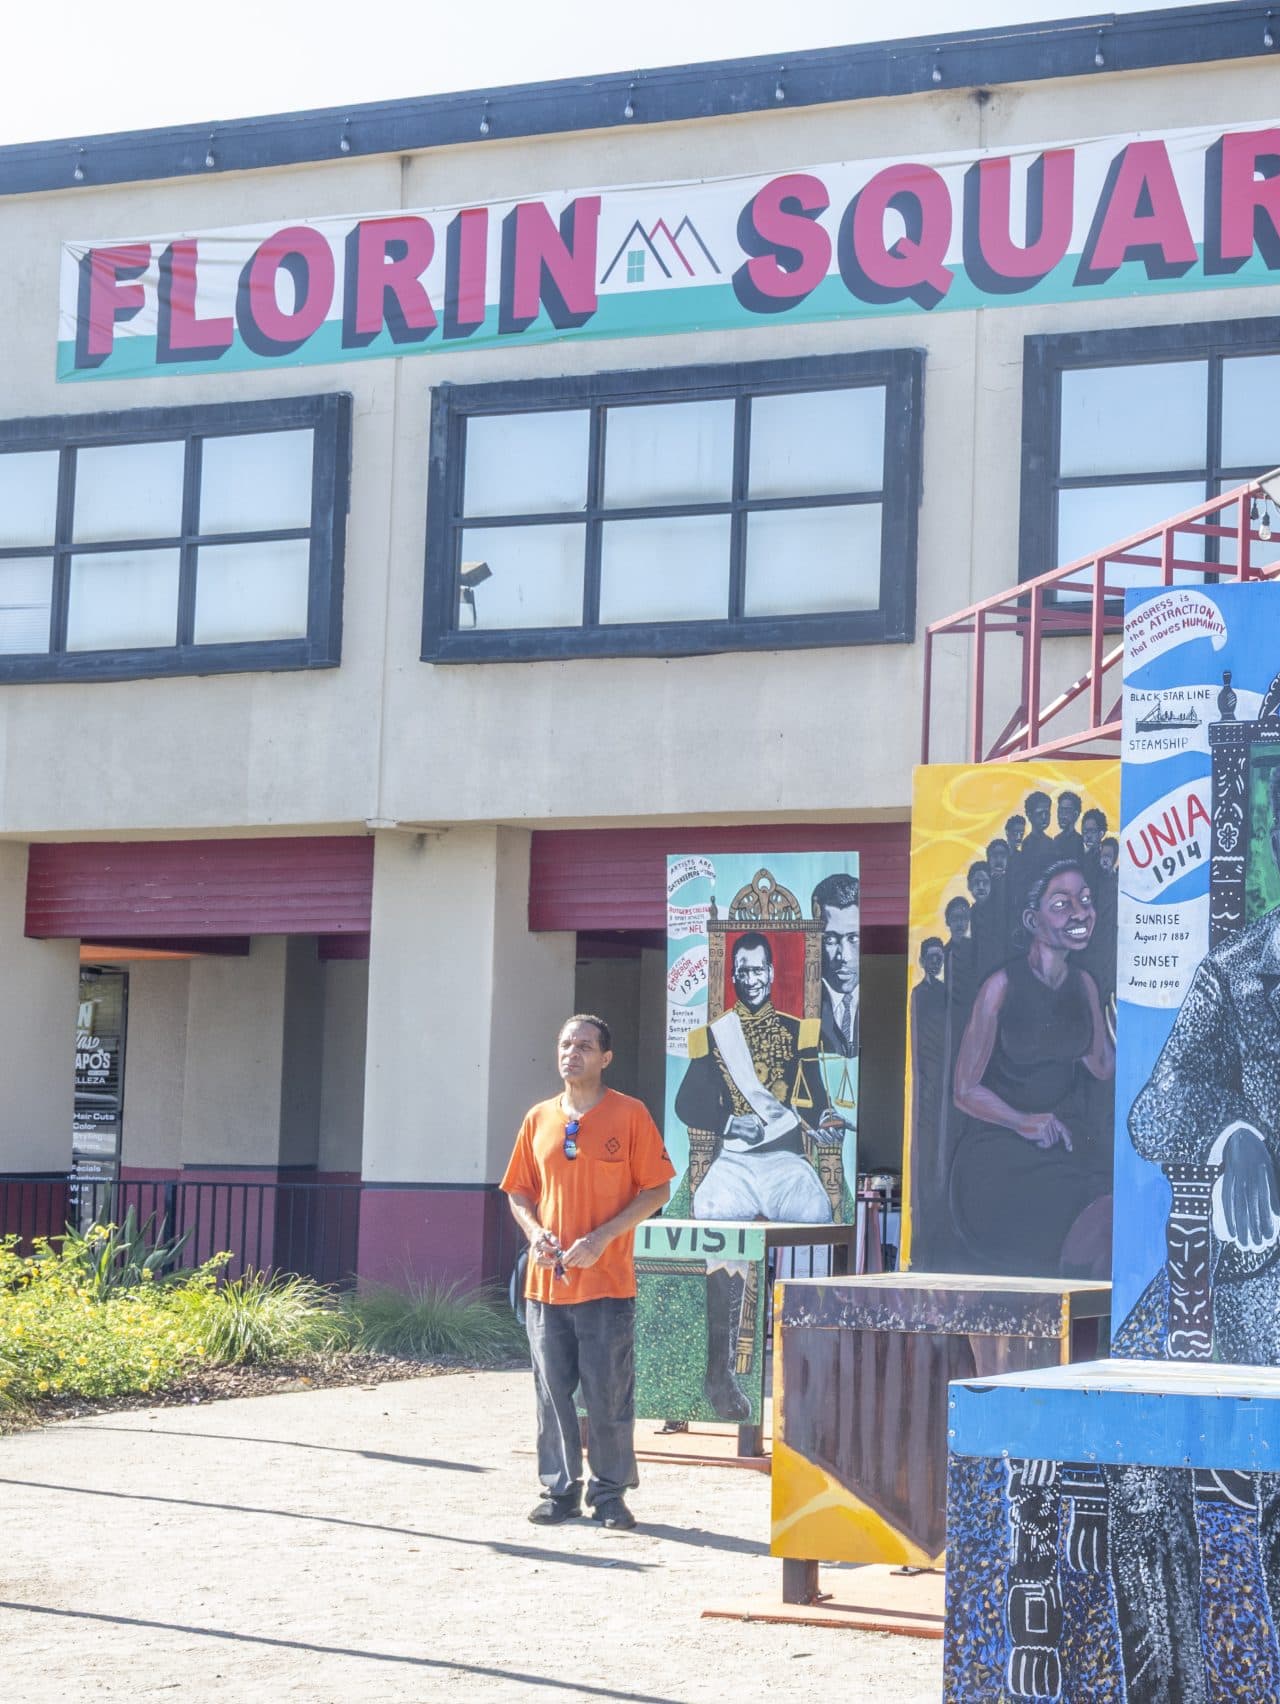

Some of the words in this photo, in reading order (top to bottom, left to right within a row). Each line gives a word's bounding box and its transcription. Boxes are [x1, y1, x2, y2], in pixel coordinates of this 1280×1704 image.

[75, 195, 600, 369] FLORIN
[1125, 598, 1173, 632] PROGRESS
[1179, 594, 1190, 603] is
[1129, 628, 1145, 642] the
[1149, 604, 1215, 630] ATTRACTION
[1130, 641, 1148, 658] that
[1149, 622, 1181, 643] moves
[1181, 617, 1226, 635] HUMANITY
[1130, 693, 1160, 702] BLACK
[1162, 691, 1185, 701] STAR
[1187, 689, 1211, 700] LINE
[1129, 737, 1189, 751] STEAMSHIP
[1126, 793, 1212, 869] UNIA
[1152, 840, 1202, 884] 1914
[688, 924, 705, 934] NFL
[1135, 914, 1180, 925] SUNRISE
[1133, 955, 1179, 968] SUNSET
[680, 969, 707, 994] 1933
[73, 1111, 92, 1120] Hair
[93, 1112, 116, 1121] Cuts
[72, 1122, 97, 1130] Color
